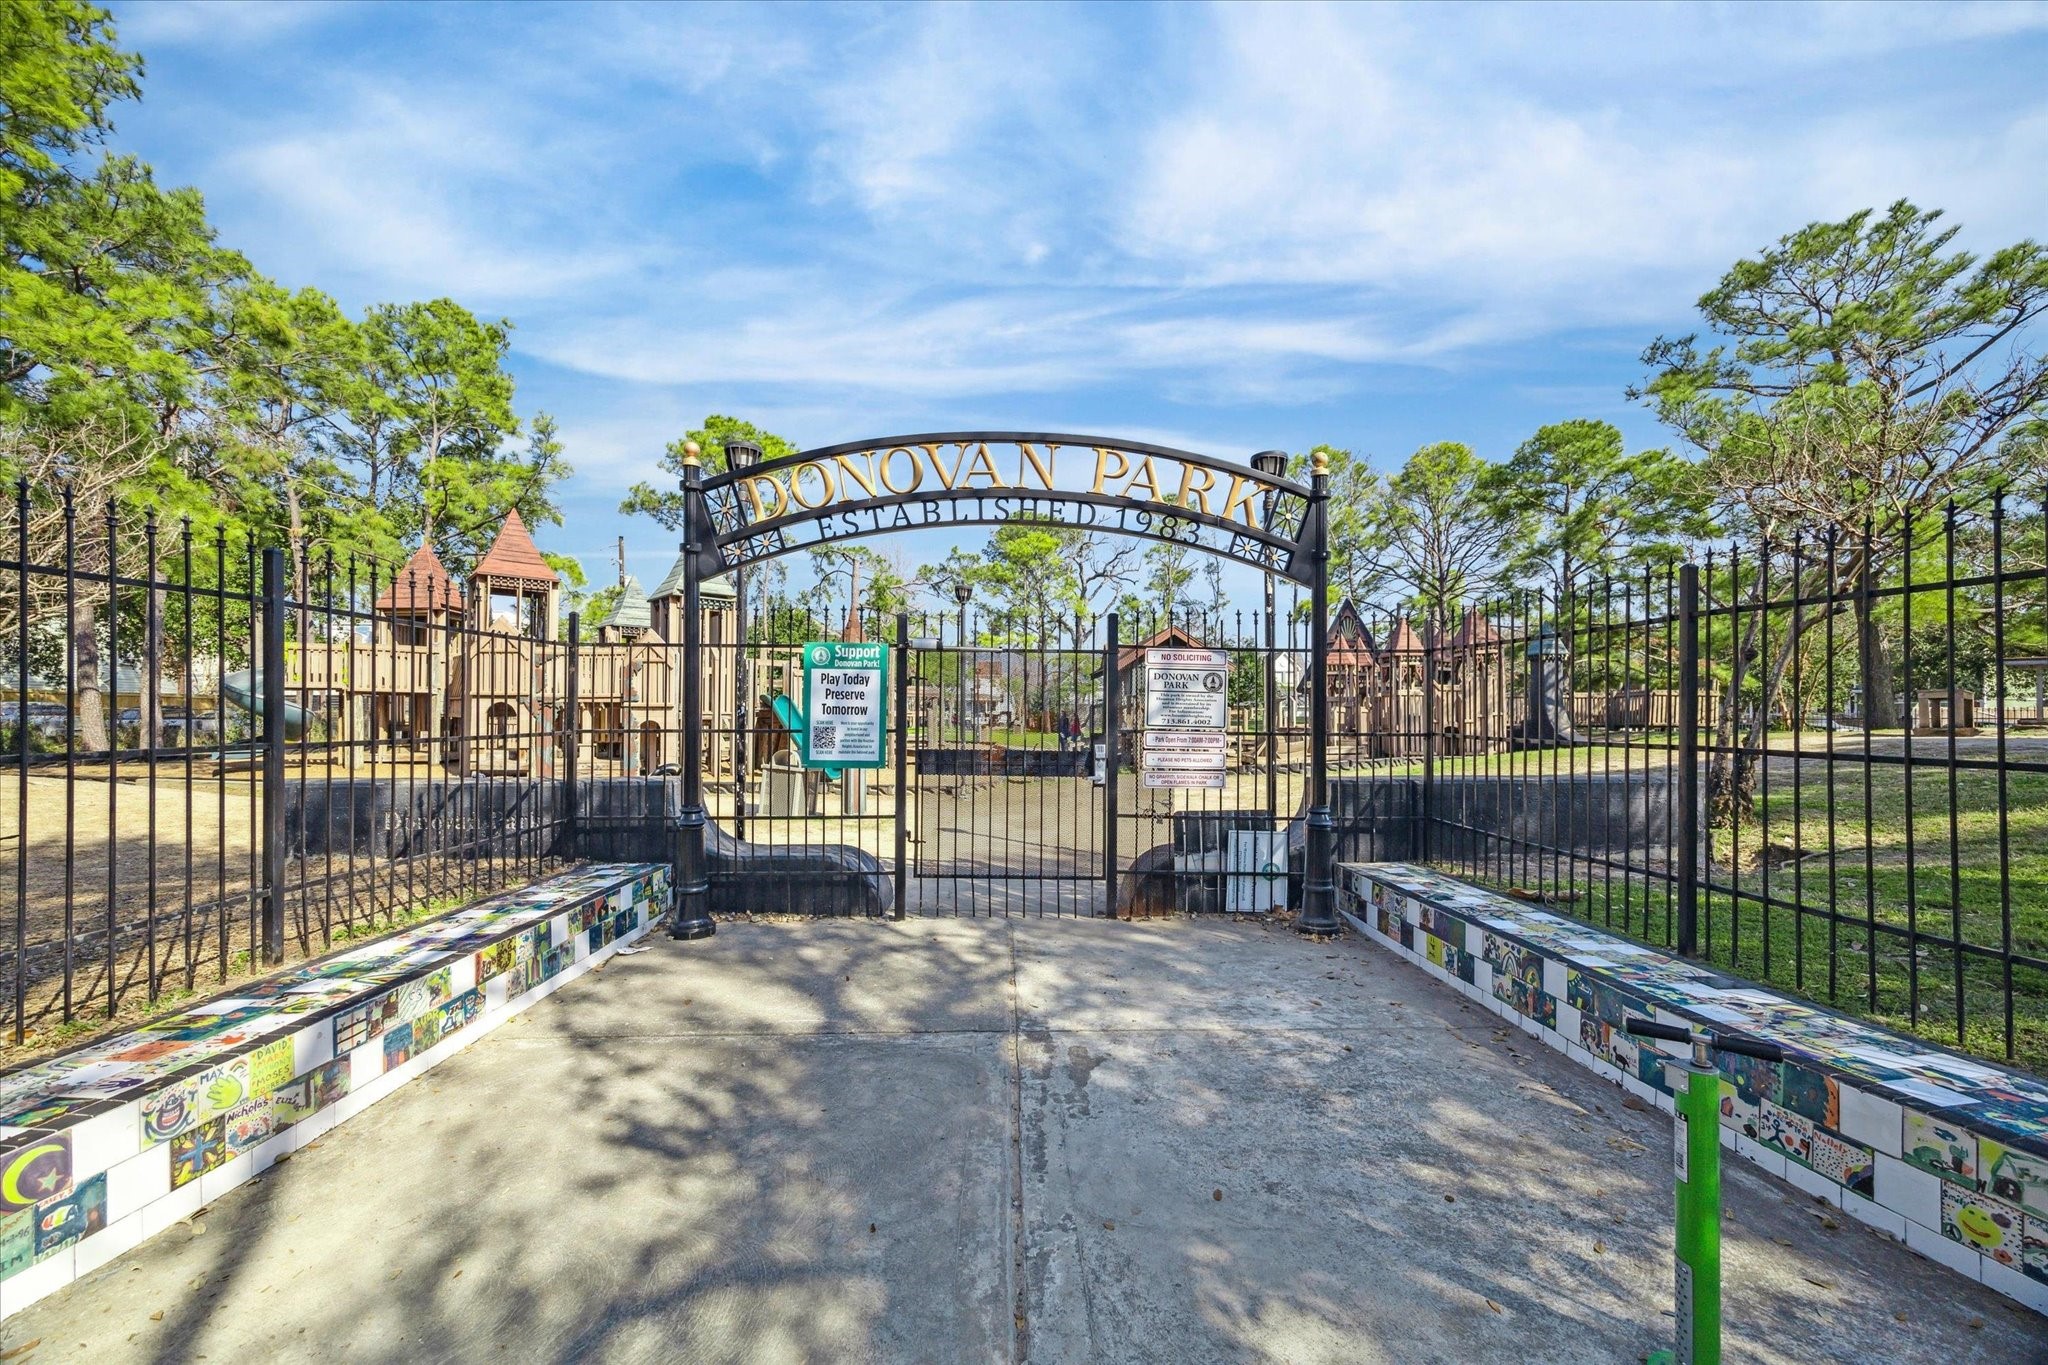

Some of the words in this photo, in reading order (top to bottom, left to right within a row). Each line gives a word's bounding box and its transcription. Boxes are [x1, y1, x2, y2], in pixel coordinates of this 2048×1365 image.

[741, 441, 1059, 525] DONOVAN
[1088, 446, 1273, 532] PARK
[816, 496, 1097, 543] ESTABLISHED
[1115, 506, 1202, 546] 1983
[835, 645, 880, 660] Support
[1173, 654, 1212, 662] SOLICITING
[820, 673, 840, 686] Play
[843, 674, 870, 687] Today
[1154, 672, 1200, 681] DONOVAN
[1164, 681, 1189, 689] PARK
[825, 688, 865, 700] Preserve
[822, 703, 868, 716] Tomorrow
[257, 1040, 288, 1060] DAVID
[200, 1067, 224, 1085] MAX
[256, 1065, 290, 1087] MOSES
[227, 1099, 268, 1124] Nicholas
